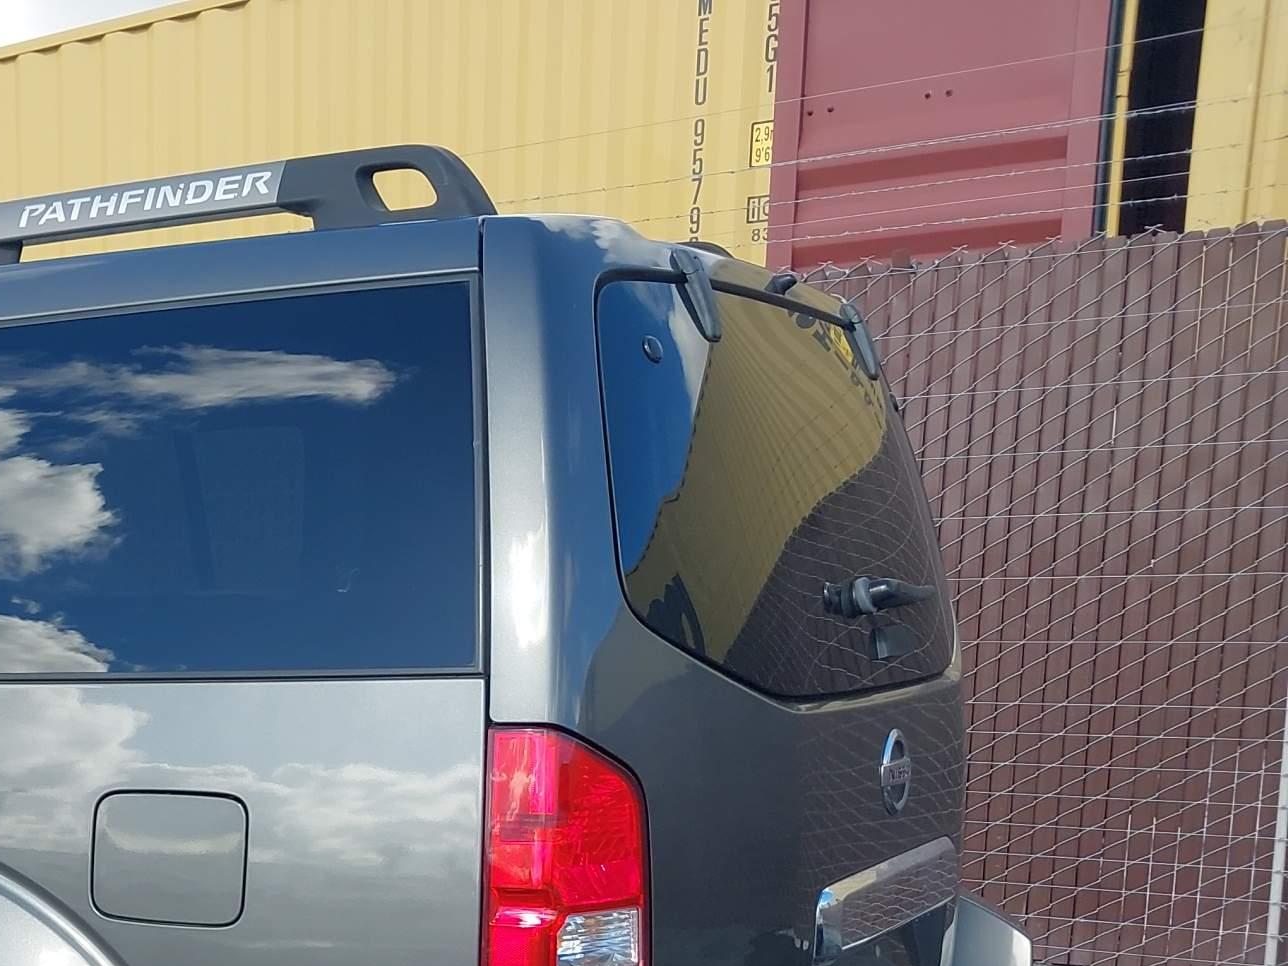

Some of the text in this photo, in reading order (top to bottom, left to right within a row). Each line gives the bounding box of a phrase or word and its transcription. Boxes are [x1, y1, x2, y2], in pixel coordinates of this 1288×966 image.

[765, 0, 779, 93] 5G1
[18, 171, 273, 228] PATHFINDER
[686, 118, 705, 242] 9579
